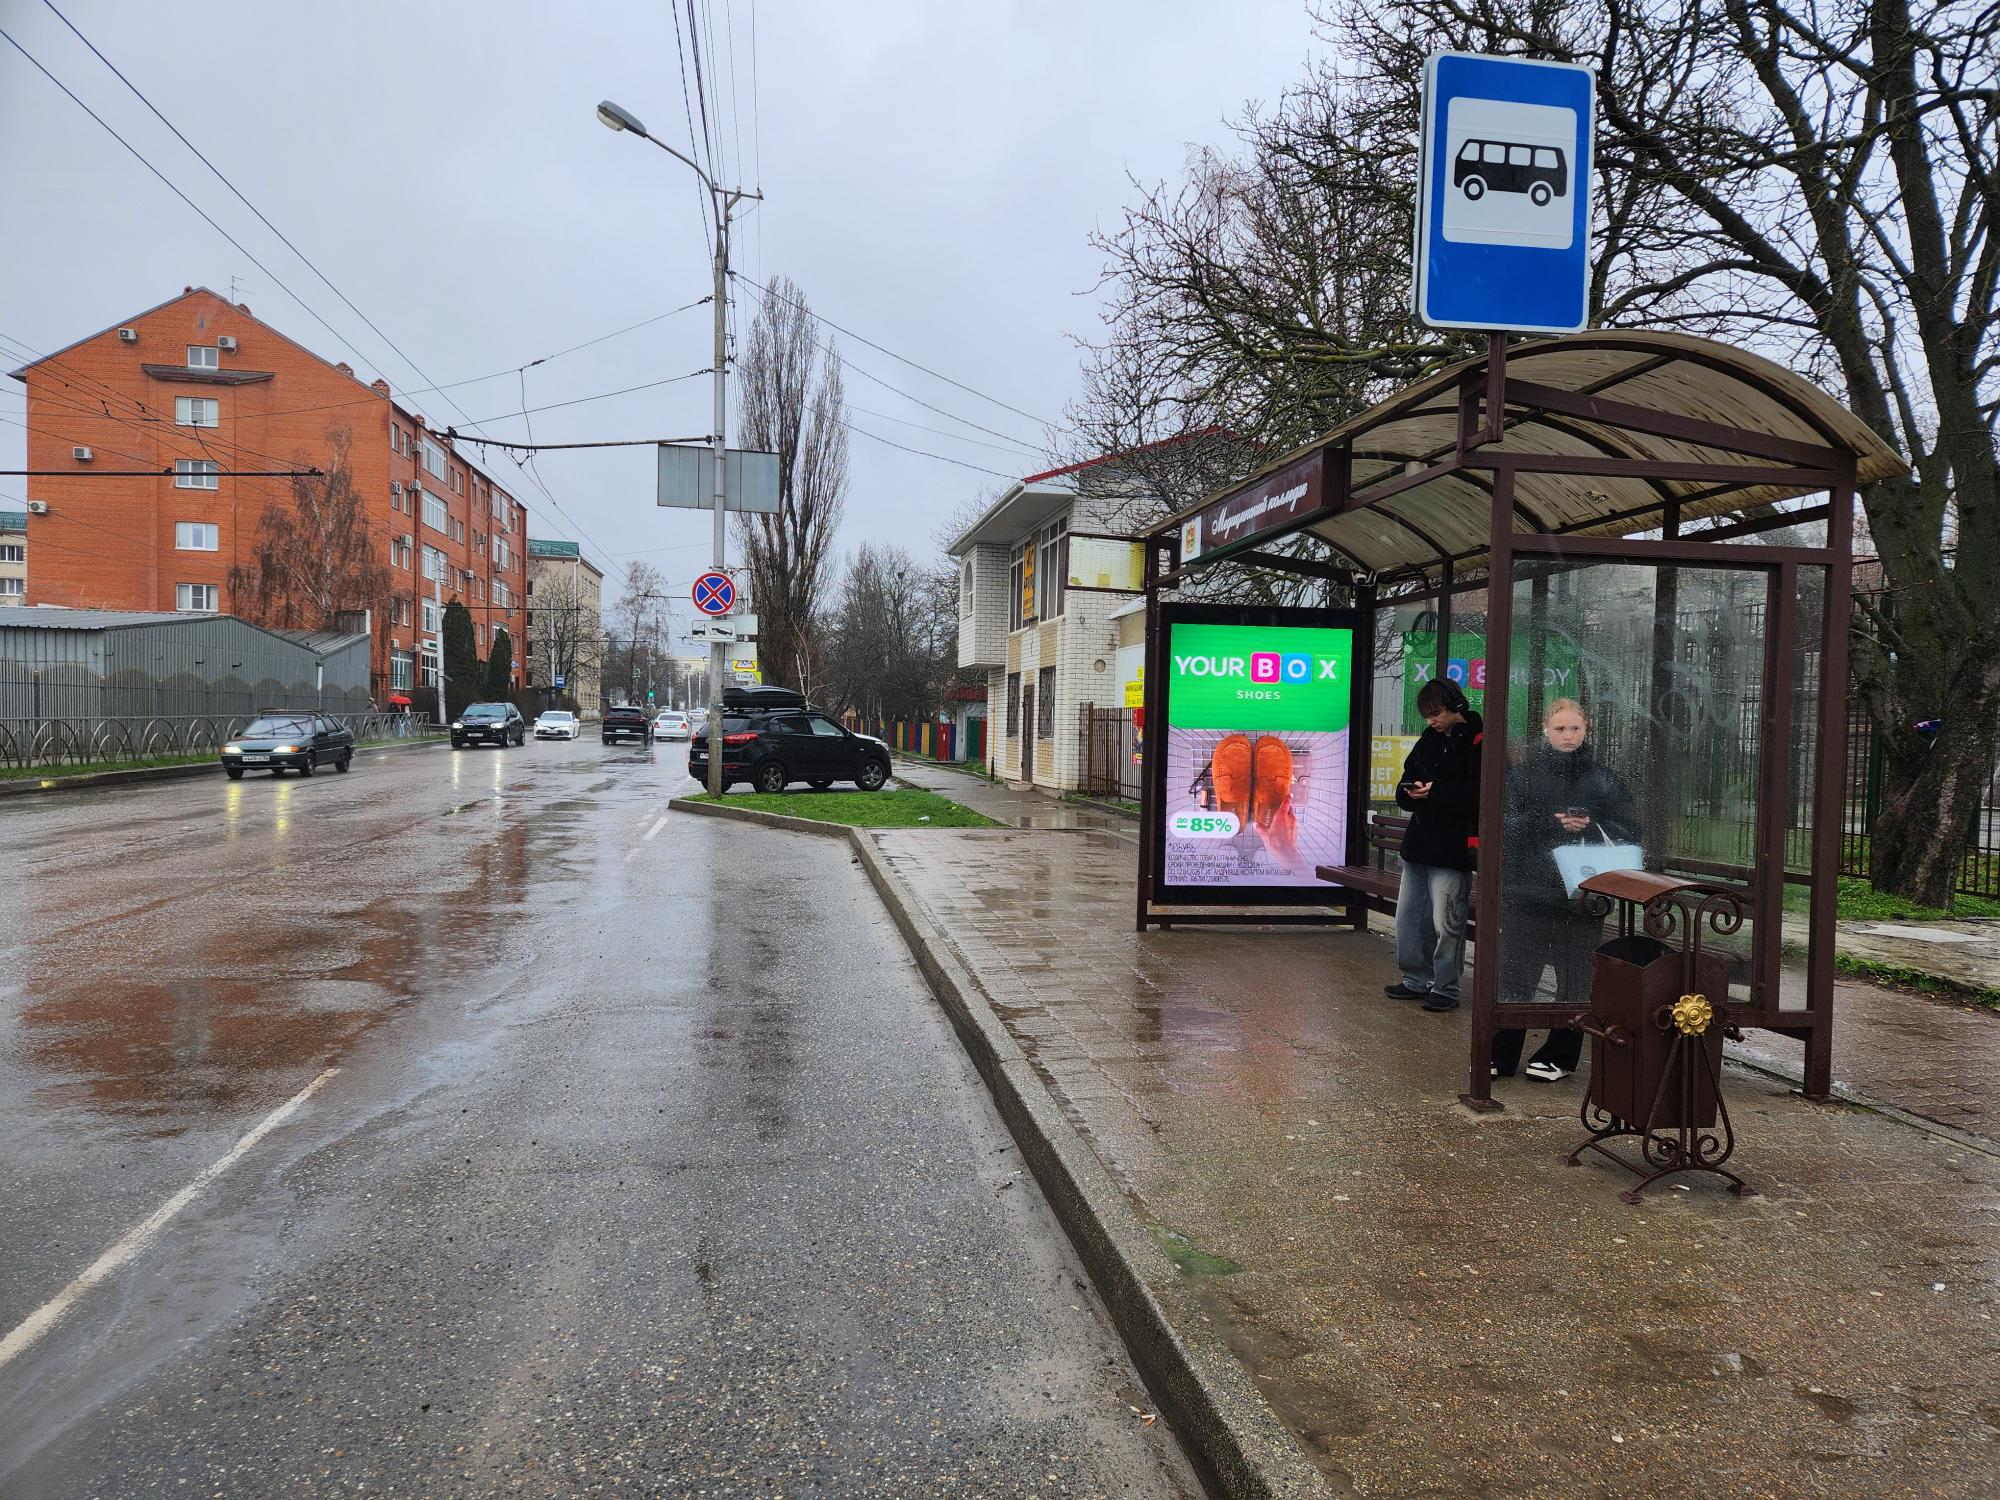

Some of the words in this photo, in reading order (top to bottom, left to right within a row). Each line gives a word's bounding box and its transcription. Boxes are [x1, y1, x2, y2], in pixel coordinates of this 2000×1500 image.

[1211, 495, 1267, 540] Медицинский
[1267, 482, 1308, 512] колледж
[1174, 656, 1245, 677] YOUR
[1236, 690, 1281, 700] SHOES
[1190, 817, 1232, 832] 85%
